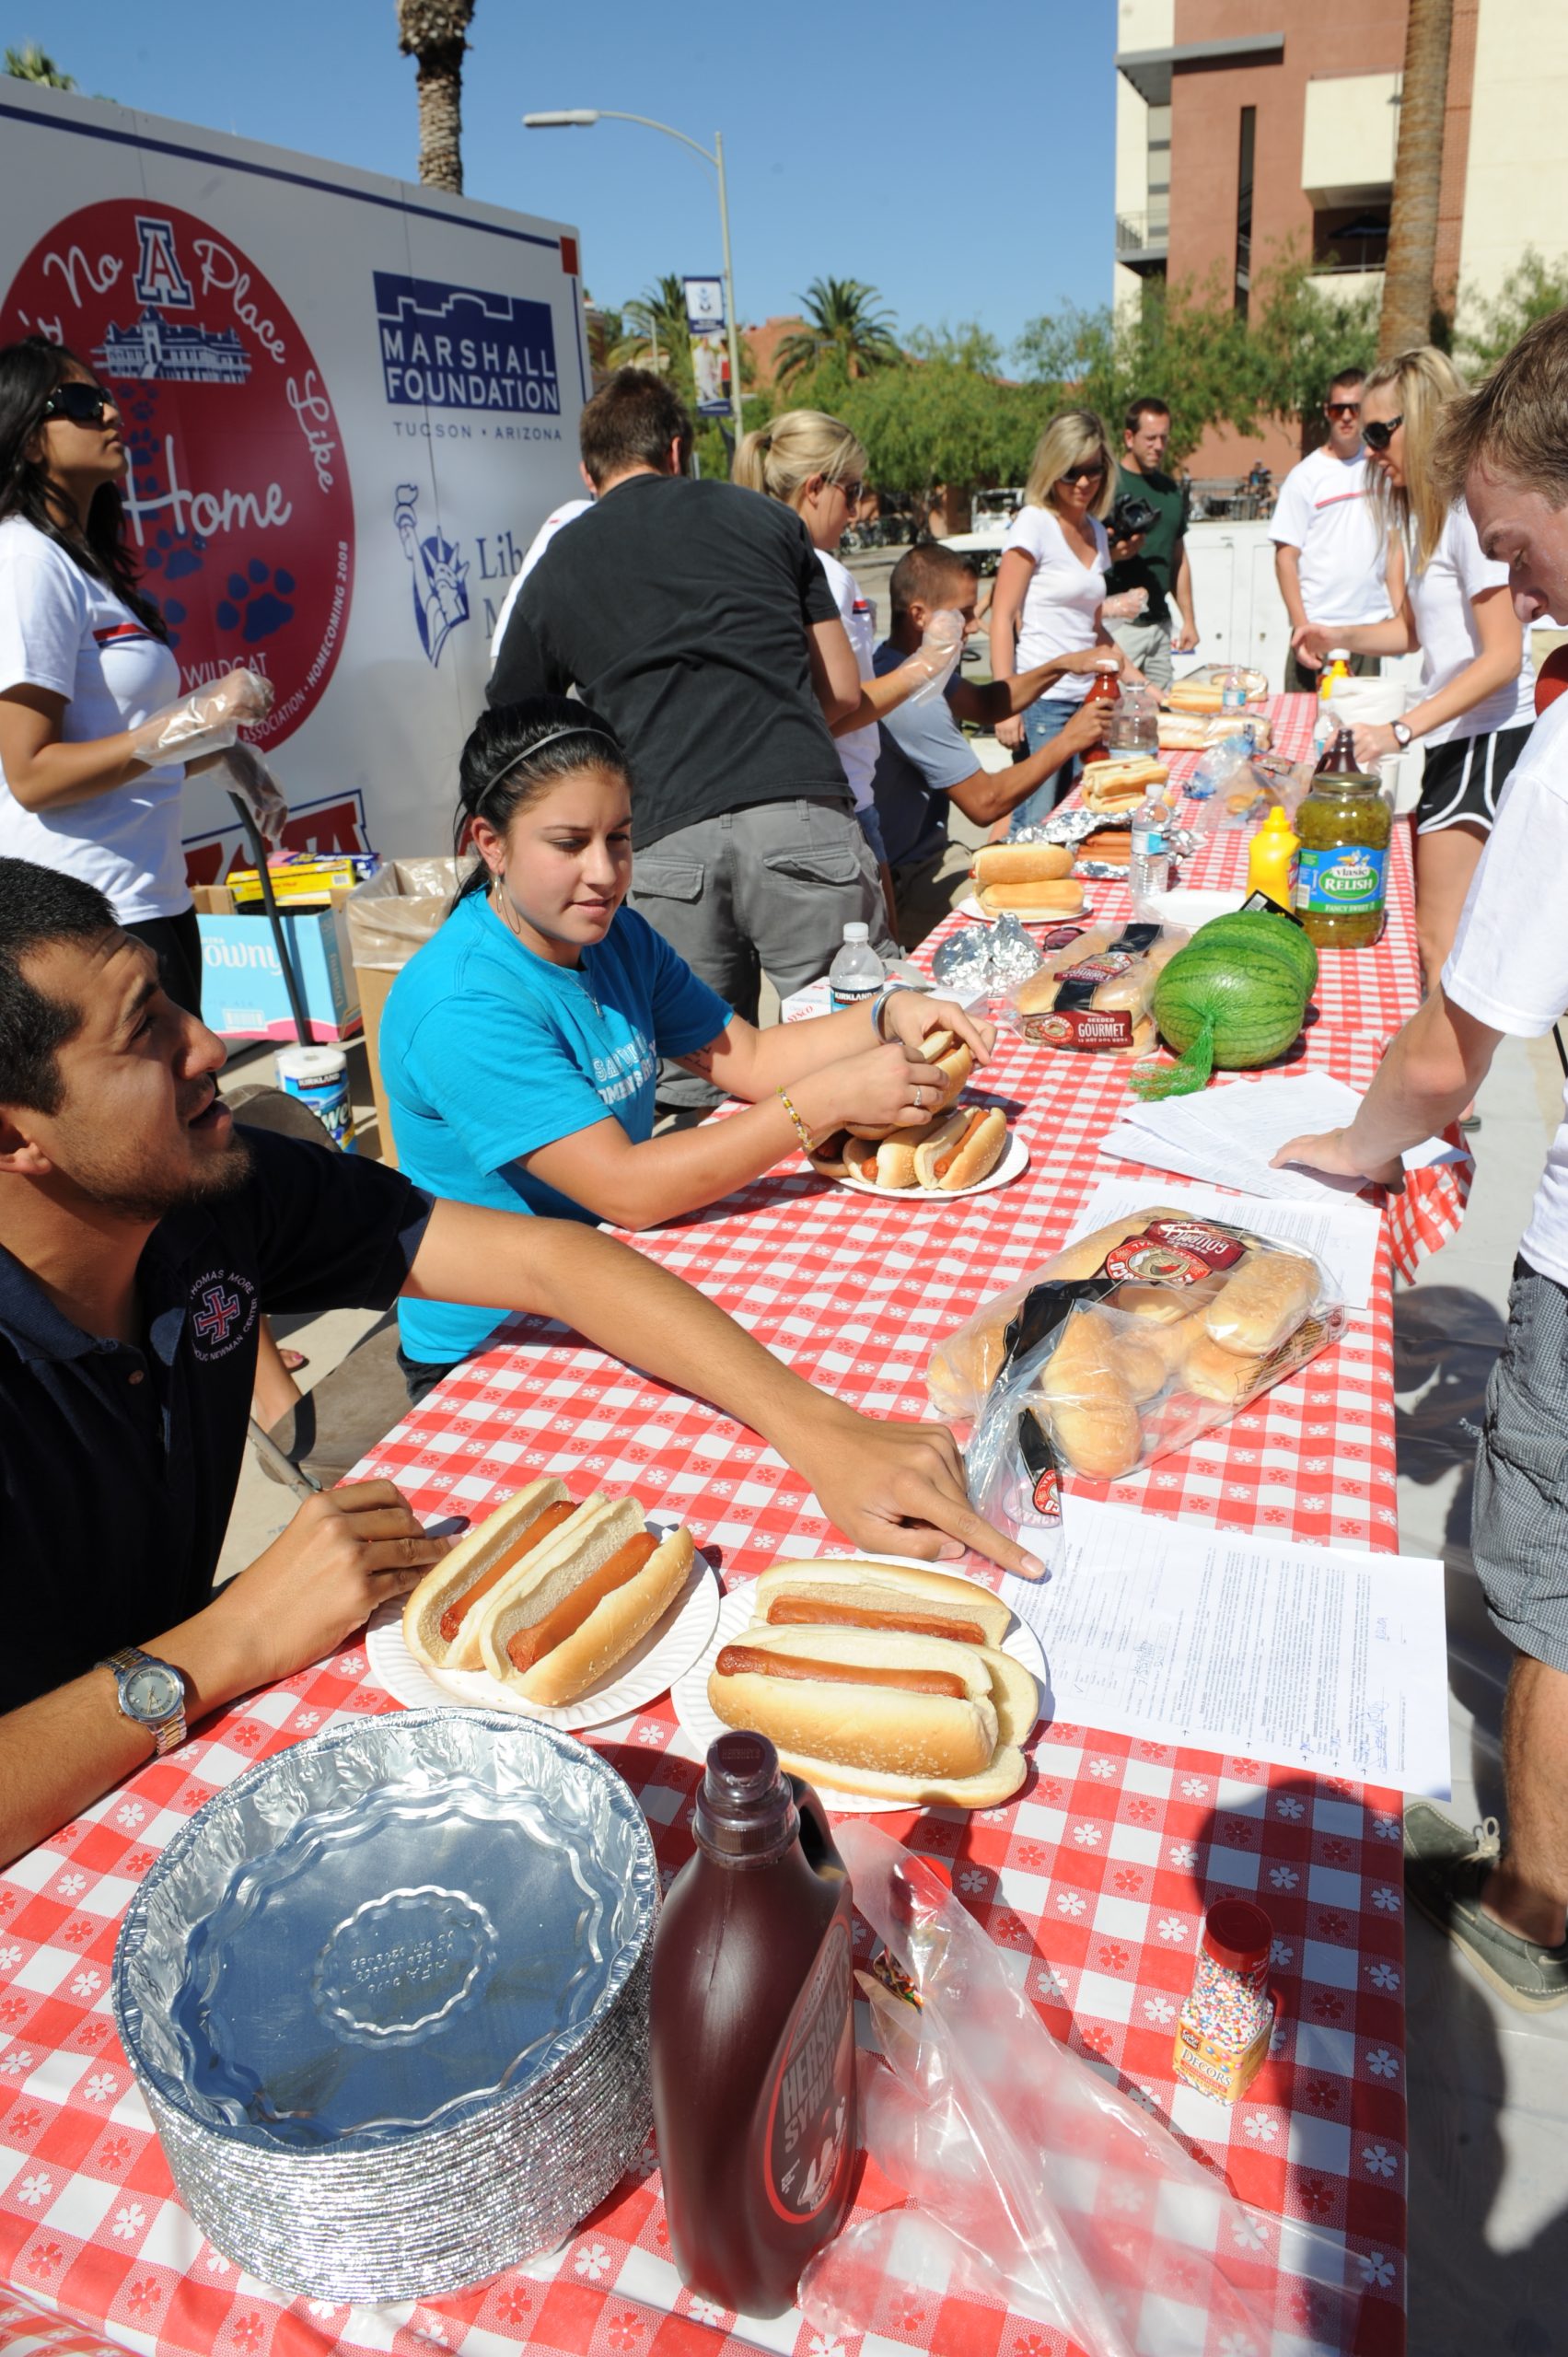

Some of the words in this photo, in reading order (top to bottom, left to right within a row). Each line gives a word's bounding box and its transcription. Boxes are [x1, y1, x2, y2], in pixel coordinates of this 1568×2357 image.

[134, 215, 195, 310] A
[43, 245, 123, 308] No
[192, 238, 286, 365] Place
[285, 368, 337, 493] Like
[382, 328, 556, 378] MARSHALL
[386, 366, 559, 412] FOUNDATION
[393, 421, 472, 439] TUCSON
[494, 426, 563, 441] ARIZONA
[122, 434, 293, 547] Home
[306, 586, 347, 688] HOMECOMING
[337, 540, 349, 585] 2008
[1324, 877, 1373, 891] RELISH
[202, 942, 284, 976] owny
[1077, 1023, 1125, 1038] GOURMET
[227, 1272, 255, 1295] MORE
[1182, 2049, 1232, 2086] DECORS
[784, 2039, 837, 2154] SYRUP
